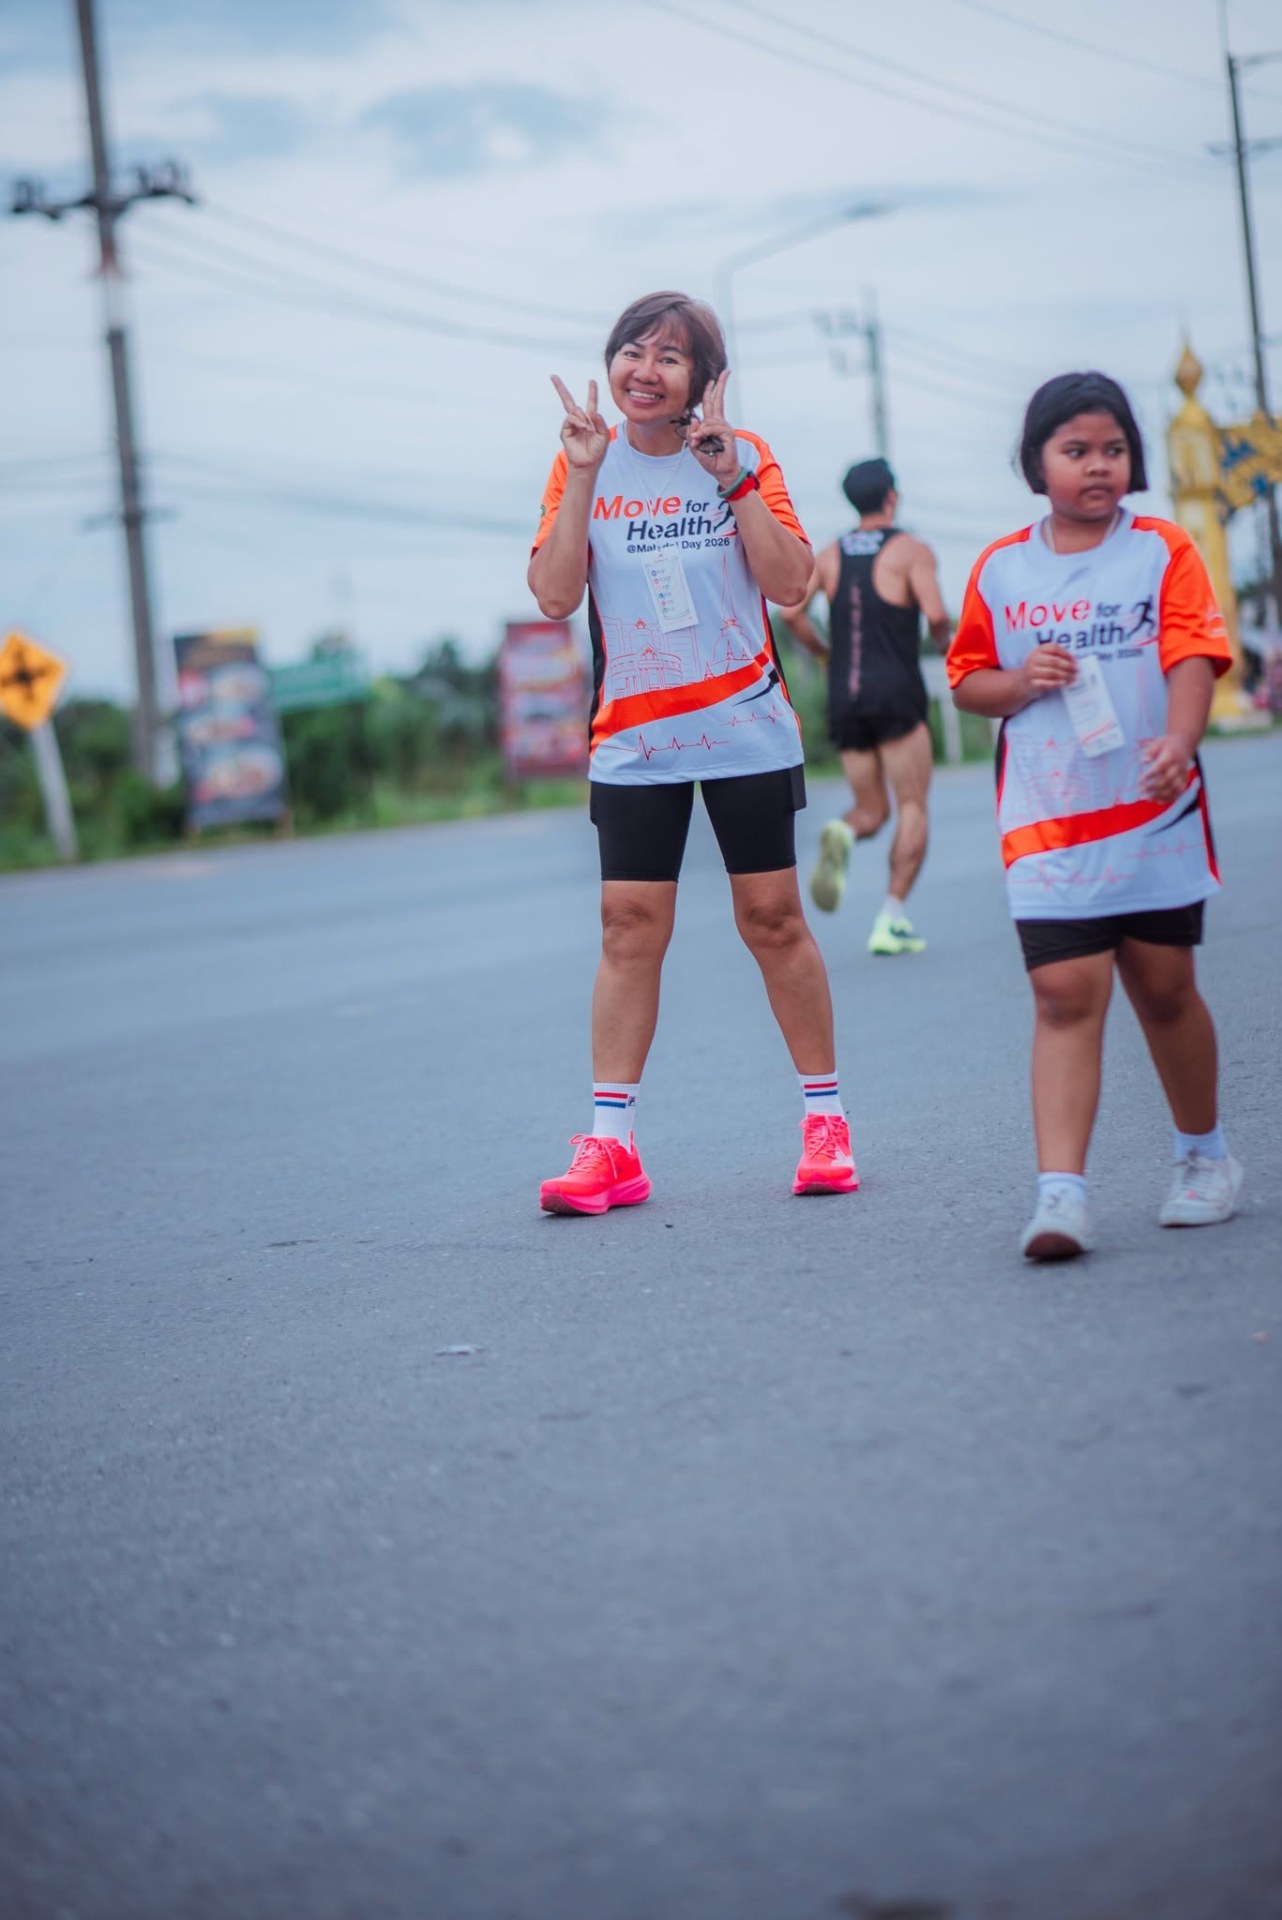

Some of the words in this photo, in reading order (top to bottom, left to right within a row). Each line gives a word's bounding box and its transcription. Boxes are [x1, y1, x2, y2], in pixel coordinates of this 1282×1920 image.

[593, 496, 681, 521] Move
[686, 500, 710, 513] for
[627, 516, 711, 540] Health
[681, 540, 702, 550] Day
[705, 538, 730, 547] 2026
[1005, 600, 1090, 633] Move
[1036, 622, 1124, 650] Health
